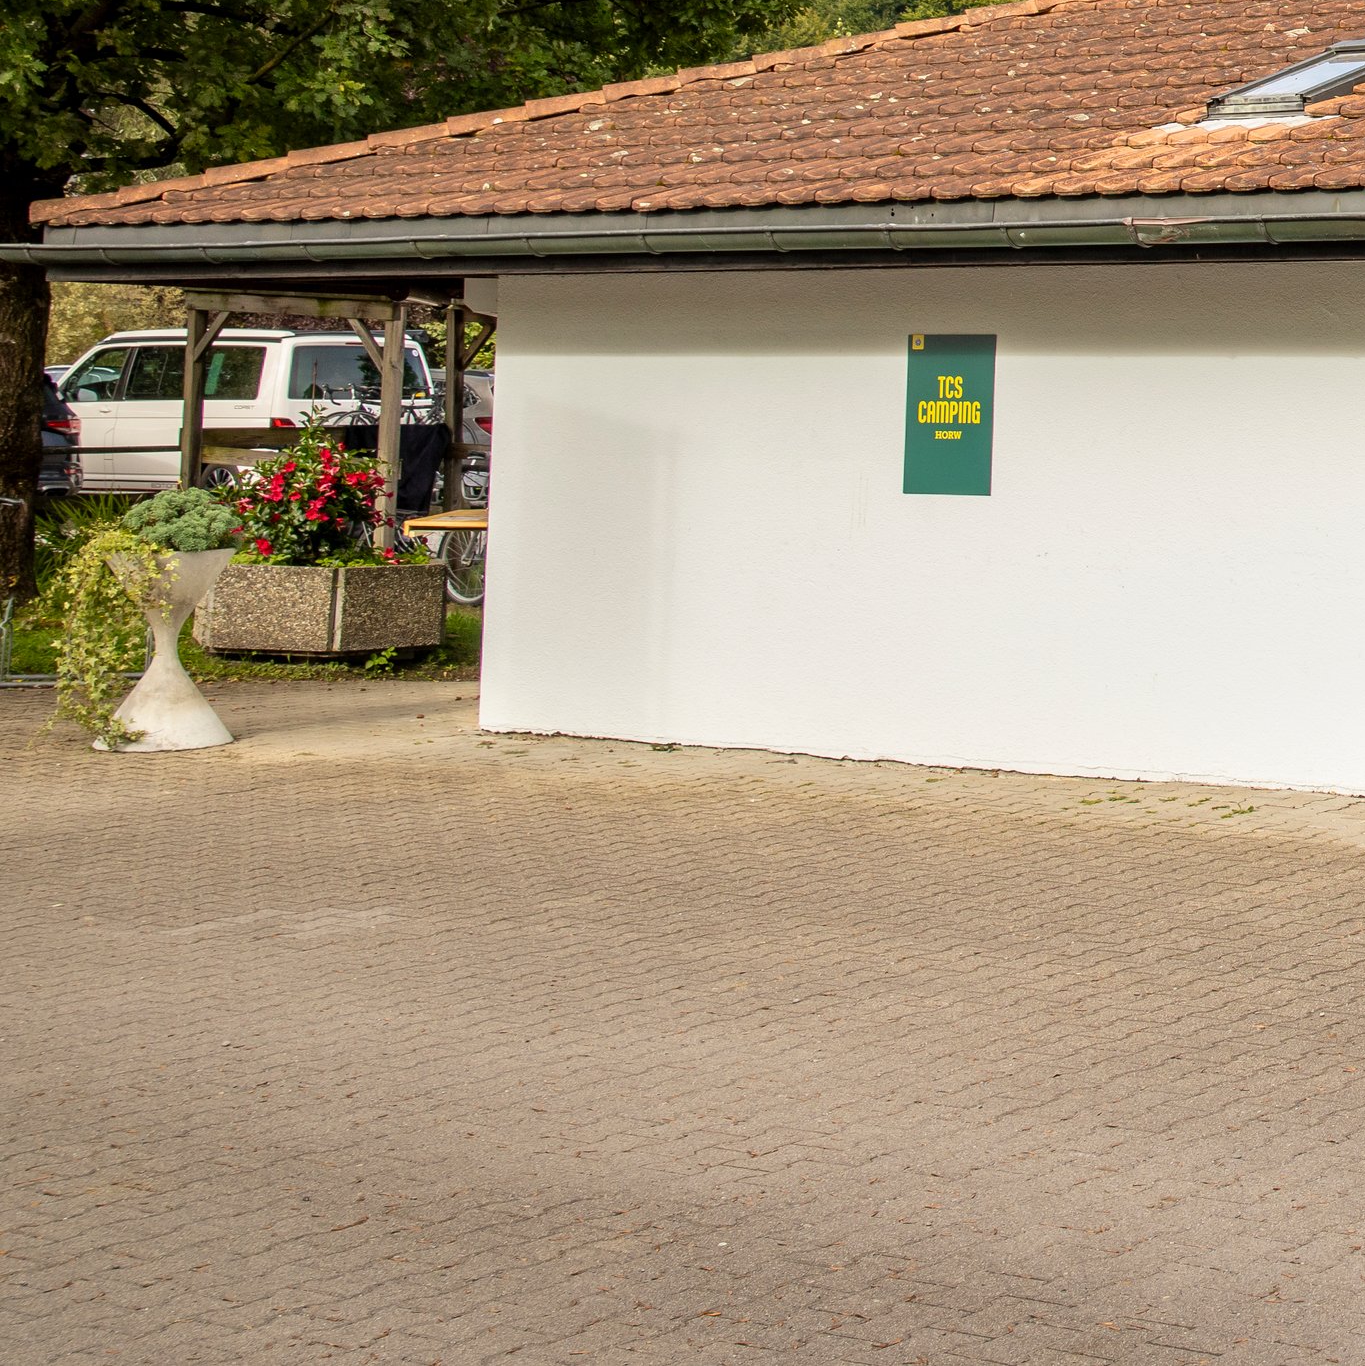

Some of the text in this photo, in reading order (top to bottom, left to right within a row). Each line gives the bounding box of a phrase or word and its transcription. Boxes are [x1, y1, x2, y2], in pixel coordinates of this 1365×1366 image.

[938, 376, 963, 399] TCS
[918, 400, 981, 424] CAMPING
[935, 430, 962, 440] HORW
